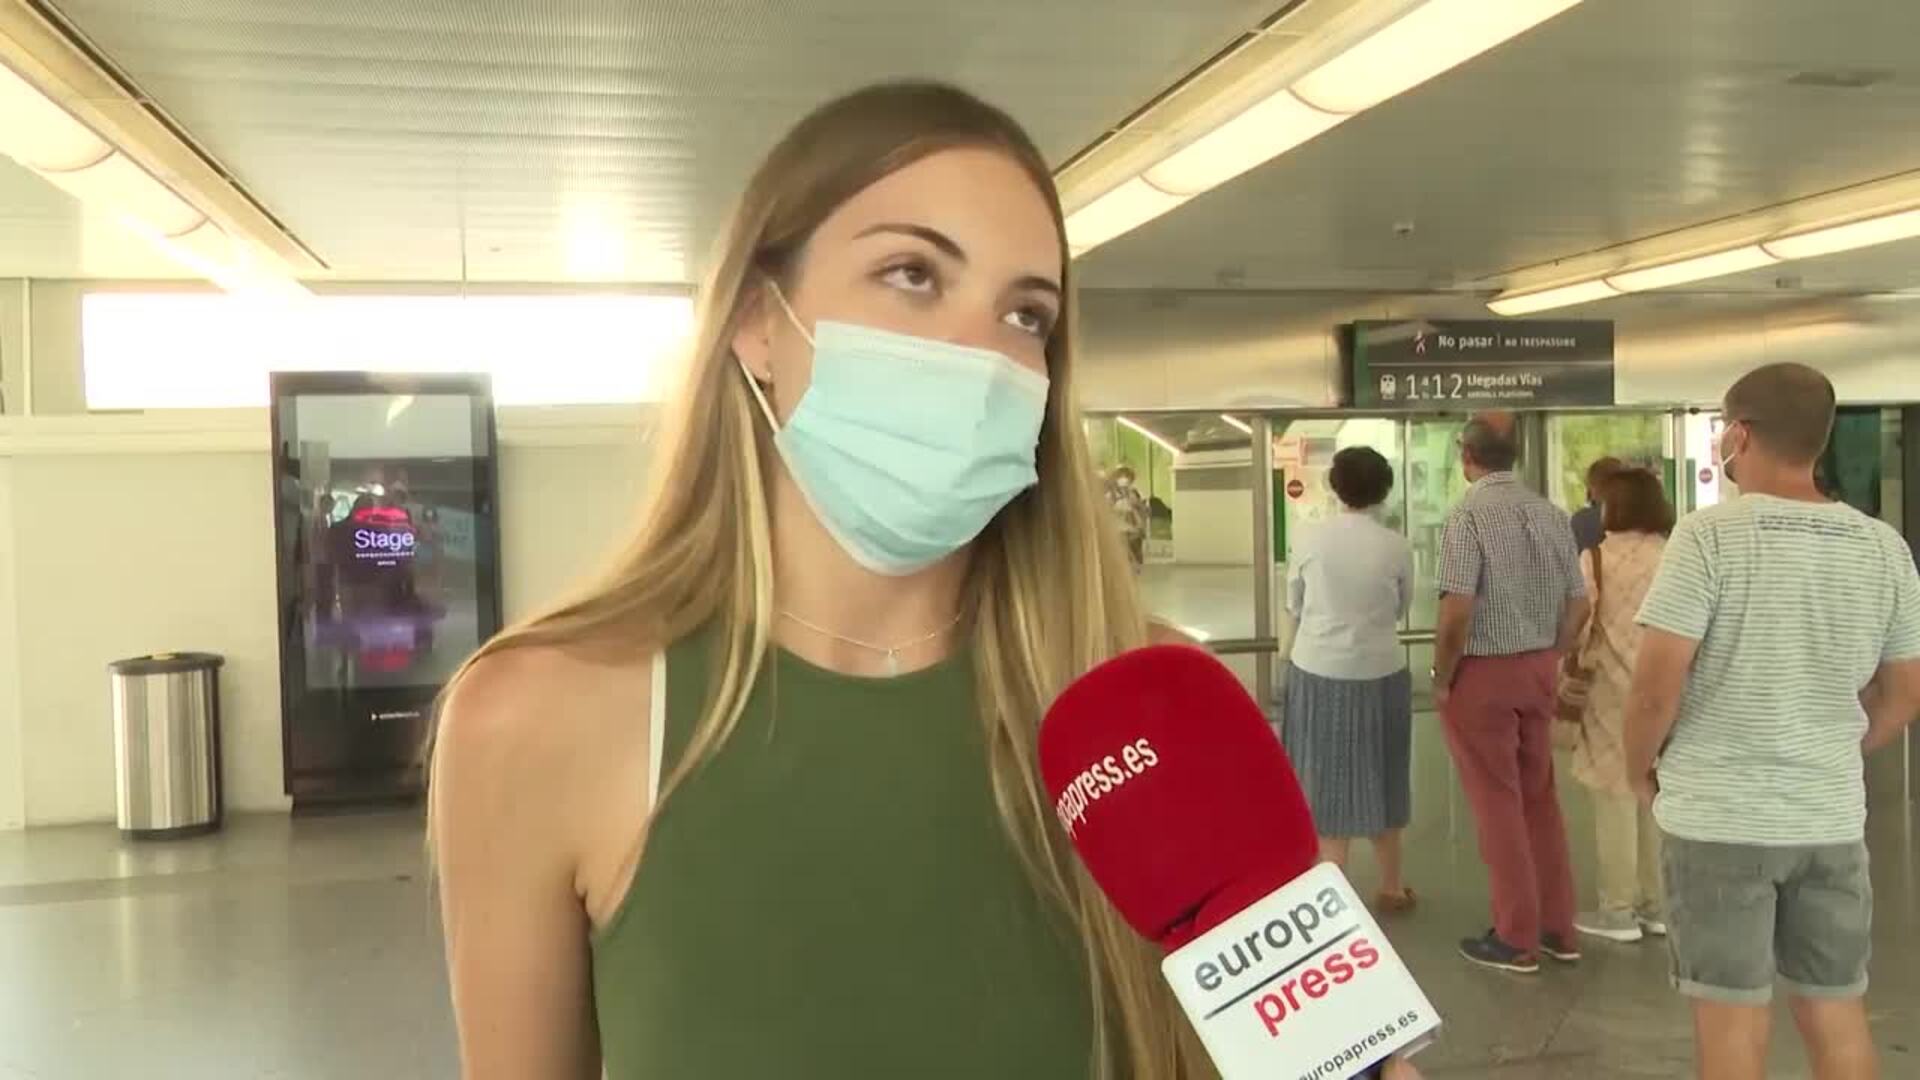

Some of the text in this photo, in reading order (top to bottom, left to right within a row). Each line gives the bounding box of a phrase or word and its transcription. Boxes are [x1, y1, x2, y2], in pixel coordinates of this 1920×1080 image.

[1438, 335, 1493, 351] No pasar
[1406, 373, 1420, 399] 1
[1431, 373, 1463, 399] 12
[1467, 374, 1517, 388] Llegadas
[354, 529, 415, 551] Stage
[1195, 886, 1348, 991] europa
[1254, 937, 1380, 1036] press
